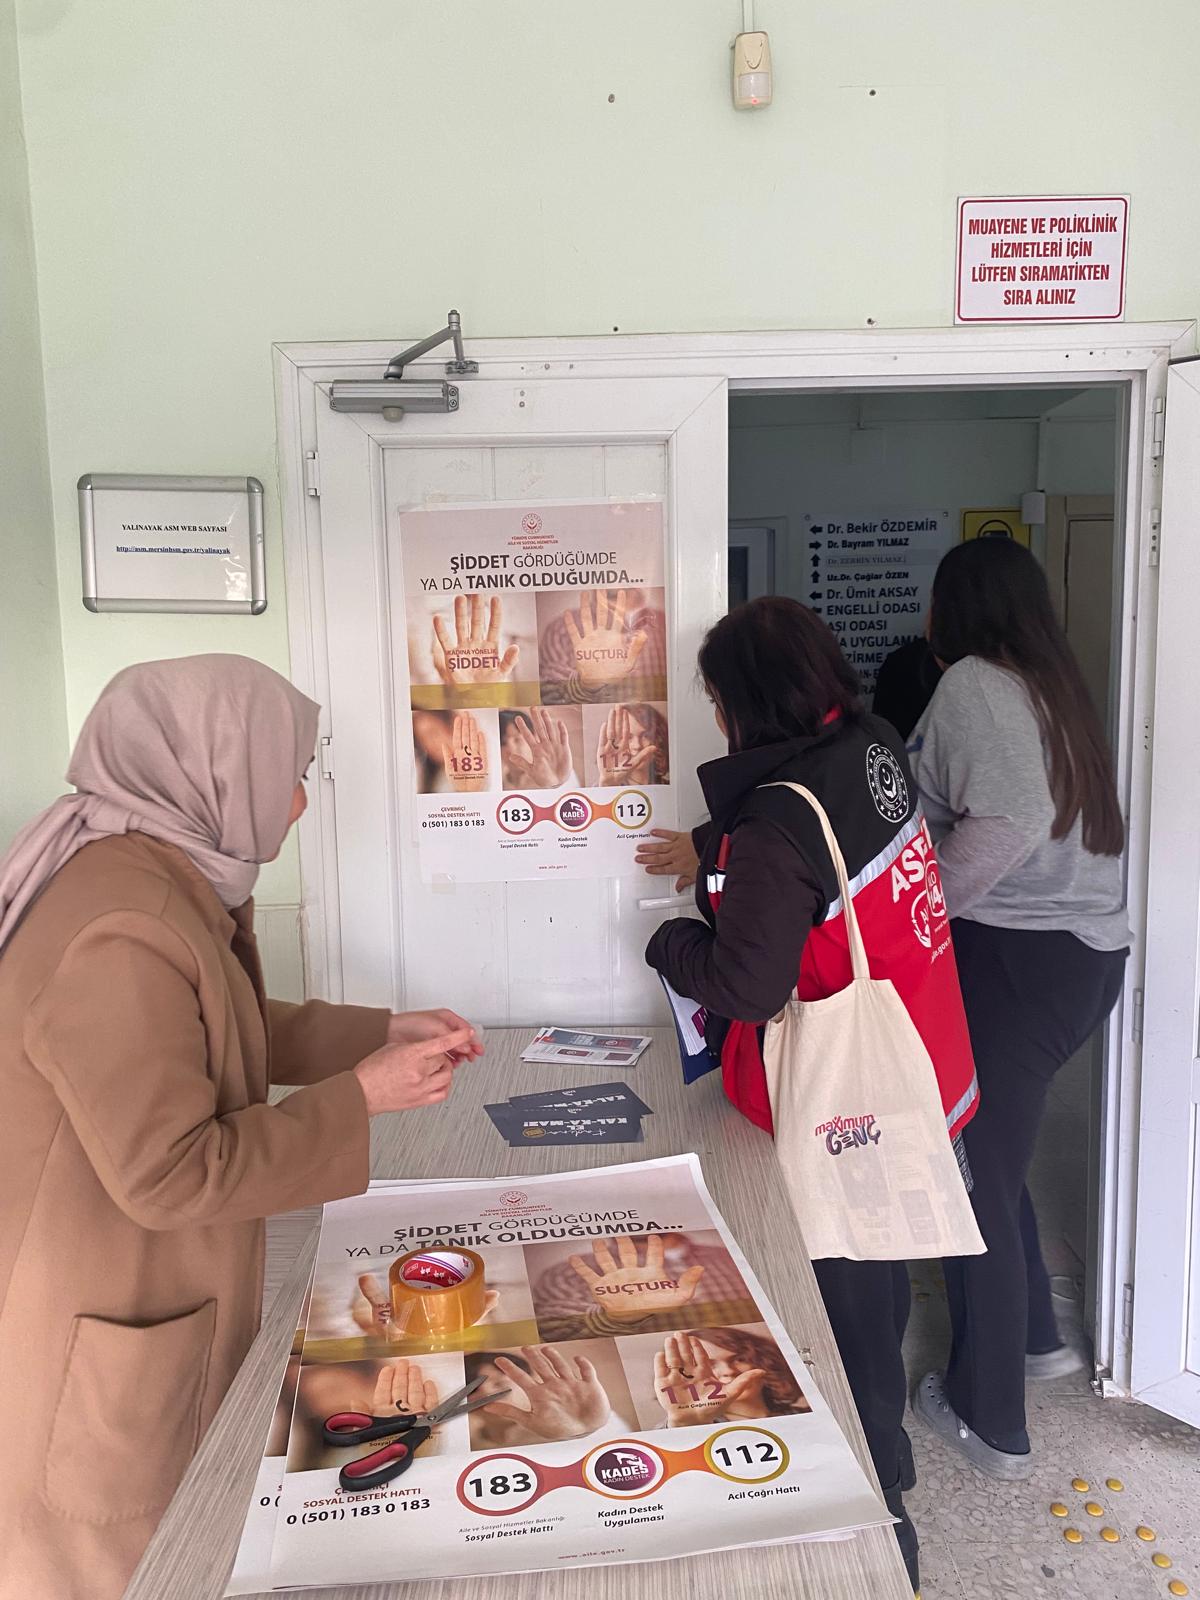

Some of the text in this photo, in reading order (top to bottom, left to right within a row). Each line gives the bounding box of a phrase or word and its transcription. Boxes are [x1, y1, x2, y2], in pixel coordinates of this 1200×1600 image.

[968, 213, 1118, 235] MUAYENE VE POLİKLİNİK
[991, 238, 1093, 260] HİZMETLERİ İÇİN
[971, 262, 1110, 282] LÜTFEN SIRAMATİKTEN
[1003, 288, 1077, 306] SIRA ALINIZ
[827, 518, 938, 534] Dr. Bekir ÖZDEMİR
[827, 537, 910, 550] Dr. Bayram YILMAZ
[450, 550, 617, 571] ŞİDDET GÖRDÜĞÜMDE
[420, 568, 644, 591] YA DA TANIK OLDUĞUMDA...
[854, 573, 883, 583] Çağlar
[885, 571, 909, 580] ÖZEN
[827, 586, 919, 600] Dr. Ümit AKSAY
[827, 603, 921, 616] ENGELLİ ODASI
[849, 620, 888, 632] ODASI
[448, 655, 499, 673] ŞİDDET
[576, 649, 628, 664] SUÇTUR!
[450, 756, 484, 772] 183
[600, 752, 633, 768] 112
[501, 808, 531, 822] 183
[617, 803, 647, 817] 112
[428, 820, 448, 828] (501)
[394, 1210, 639, 1243] ŞİDDET GÖRDÜĞÜMDE
[346, 1247, 370, 1258] YA
[379, 1243, 409, 1255] DA
[497, 1221, 684, 1245] OLDUĞUMDA...
[595, 1279, 680, 1297] SUÇTUR!
[661, 1381, 727, 1404] 112
[715, 1442, 779, 1467] 112
[601, 1464, 649, 1480] KADES
[469, 1472, 532, 1498] 183
[727, 1485, 801, 1500] Acil Çağrı Hattı
[260, 1497, 271, 1506] 0
[303, 1488, 421, 1508] SOSYAL DESTEK HATTI
[286, 1499, 431, 1525] 0 (501) 183 0 183
[598, 1503, 664, 1518] Kadın Destek
[604, 1513, 665, 1528] Uygulaması
[465, 1525, 554, 1542] Sosyal Destek Hattı
